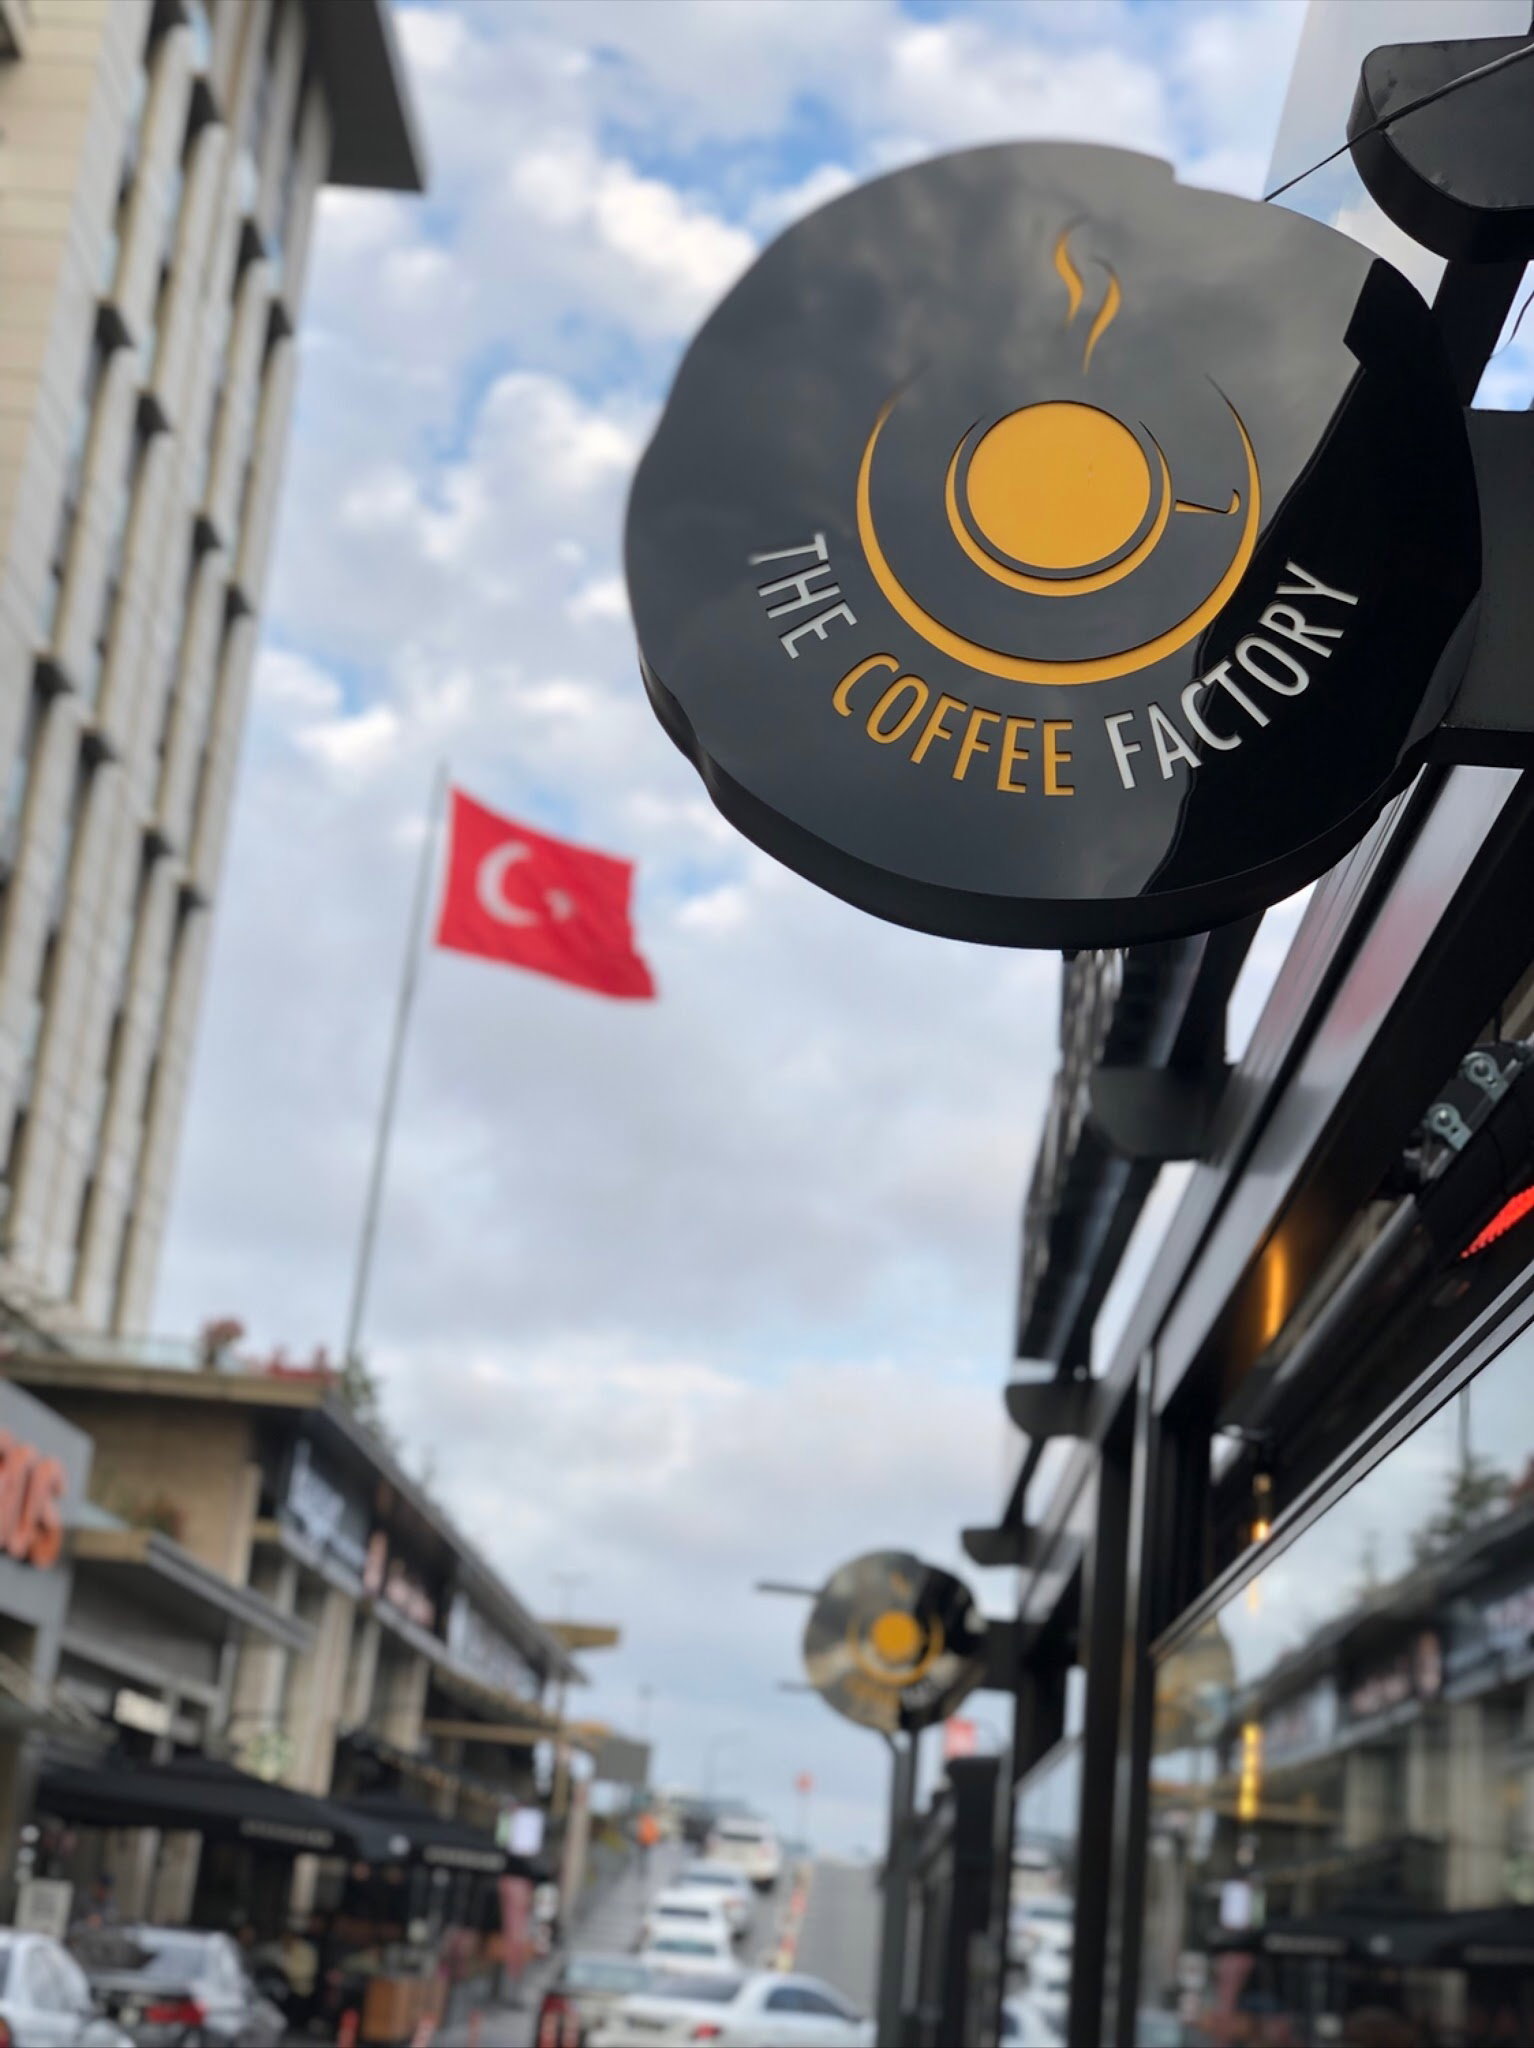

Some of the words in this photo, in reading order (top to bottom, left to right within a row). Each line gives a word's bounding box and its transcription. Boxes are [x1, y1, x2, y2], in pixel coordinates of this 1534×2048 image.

[749, 533, 857, 659] THE
[833, 653, 1074, 796] COFFEE
[1104, 560, 1359, 790] FACTORY
